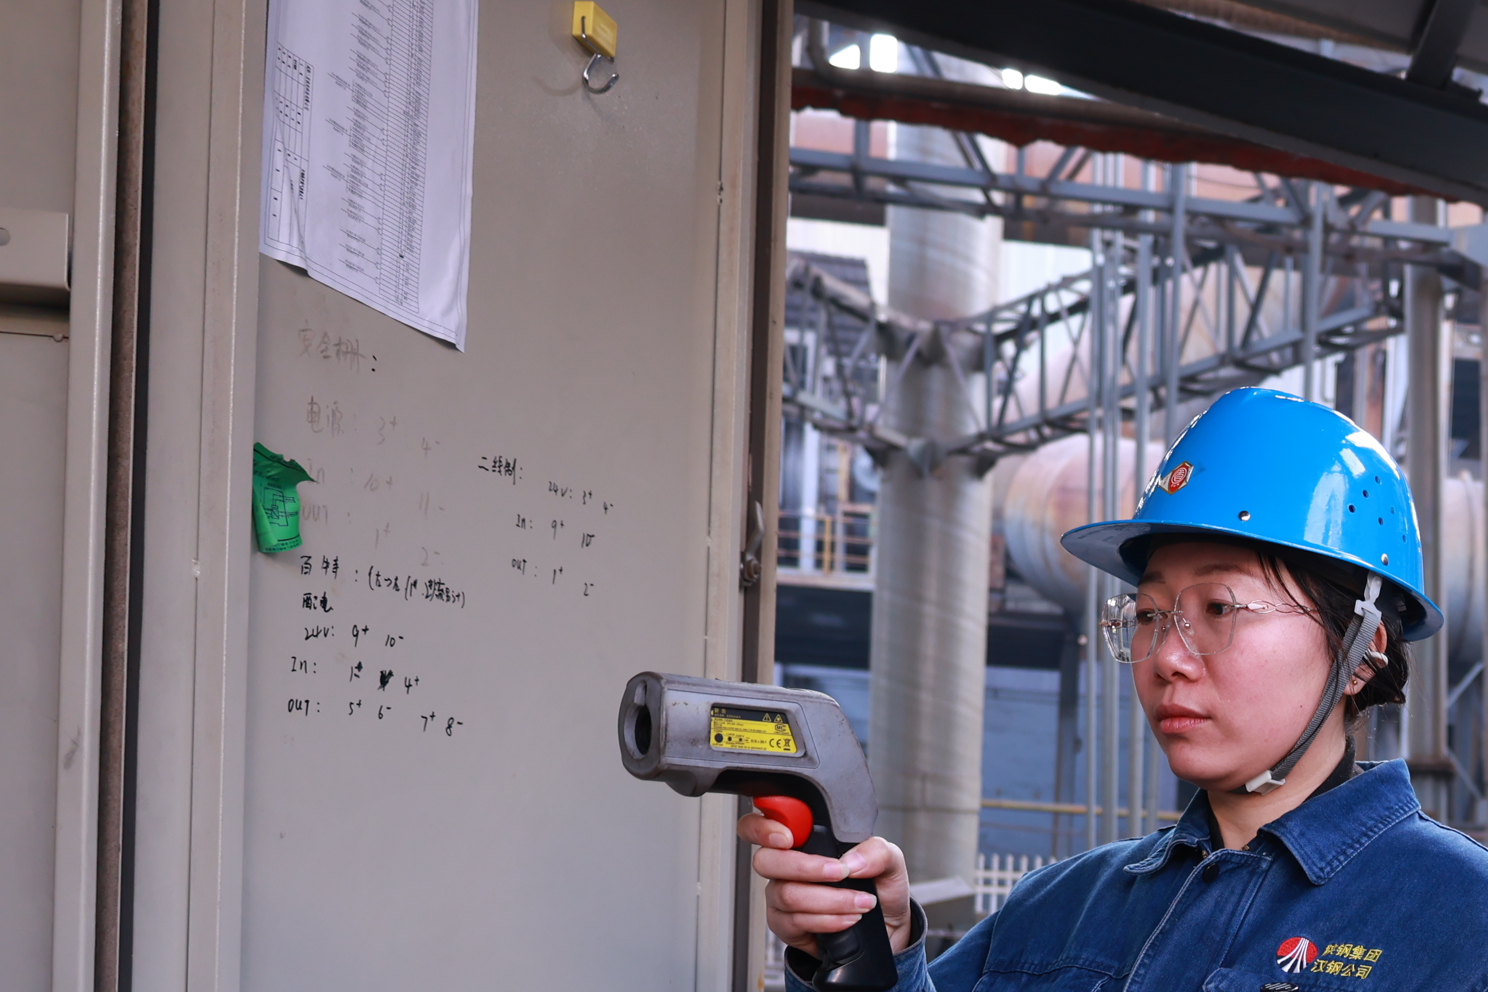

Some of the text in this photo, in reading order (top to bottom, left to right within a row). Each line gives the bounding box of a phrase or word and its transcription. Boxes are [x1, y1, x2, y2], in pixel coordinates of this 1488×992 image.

[1321, 943, 1384, 963] 陕钢集团
[1310, 959, 1374, 980] 汉钢公司
